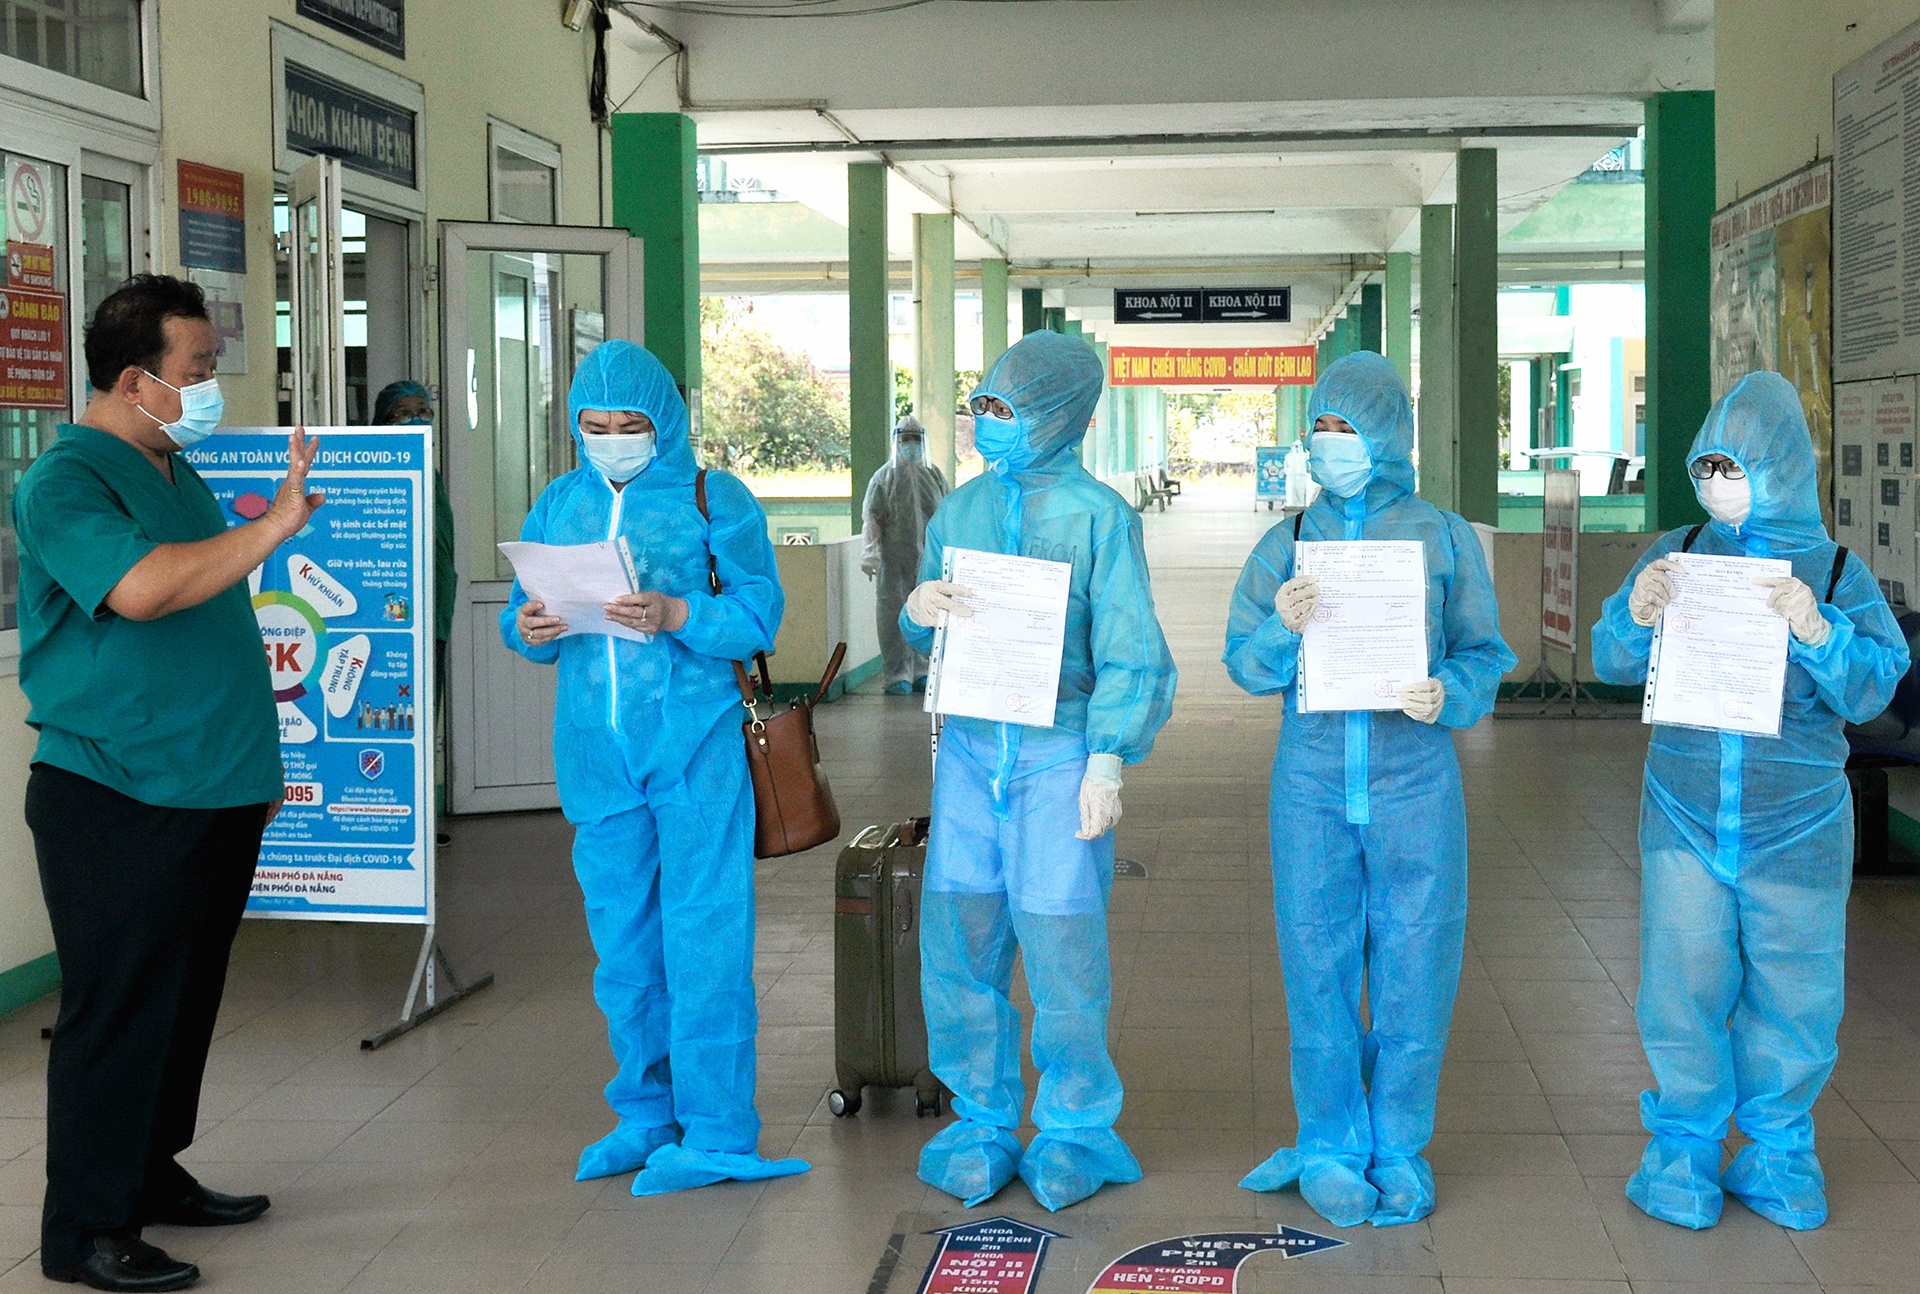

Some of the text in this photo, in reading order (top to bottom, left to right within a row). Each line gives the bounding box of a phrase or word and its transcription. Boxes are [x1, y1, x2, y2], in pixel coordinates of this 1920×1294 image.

[286, 88, 412, 172] KHOA KHÁM BỆNH
[1125, 294, 1193, 310] KHOA NỘI II
[1209, 293, 1282, 310] KHOA NỘI III
[12, 296, 60, 321] CẢNH BÁO
[1114, 353, 1130, 383] VIỆT
[1132, 356, 1149, 377] NAM
[1151, 350, 1175, 377] CHIẾN
[1176, 349, 1203, 377] THẮNG
[1203, 356, 1227, 377] COVID
[1233, 350, 1256, 377] CHẤM
[1257, 352, 1273, 377] DỨT
[1274, 352, 1296, 382] BỆNH
[1297, 357, 1312, 377] LAO
[185, 449, 273, 464] SỐNG AN TOÀN
[323, 451, 351, 466] DỊCH
[354, 451, 410, 464] COVID-19
[327, 487, 341, 496] tay
[343, 487, 367, 496] thường
[329, 520, 341, 530] Vệ
[343, 520, 360, 528] sinh
[362, 520, 376, 528] các
[390, 520, 407, 530] mặt
[327, 559, 407, 570] Giữ vệ sinh, lau rửa
[318, 584, 345, 608] KHUẨN
[259, 625, 306, 640] ÔNG ĐIỆP
[327, 648, 350, 693] TẬP TRUNG
[286, 717, 302, 727] BÁO
[266, 851, 403, 865] chúng ta trước Đại dịch COVID-19
[281, 870, 343, 882] PHỐ ĐÀ NẴNG
[294, 883, 307, 892] ĐÀ
[309, 883, 336, 894] NẴNG
[1262, 1238, 1316, 1246] THU
[949, 1259, 996, 1268] NỘI
[940, 1268, 1024, 1278] NỘI III
[1113, 1273, 1153, 1283] HEN
[1172, 1275, 1225, 1286] COPD
[960, 1278, 1000, 1286] 15m
